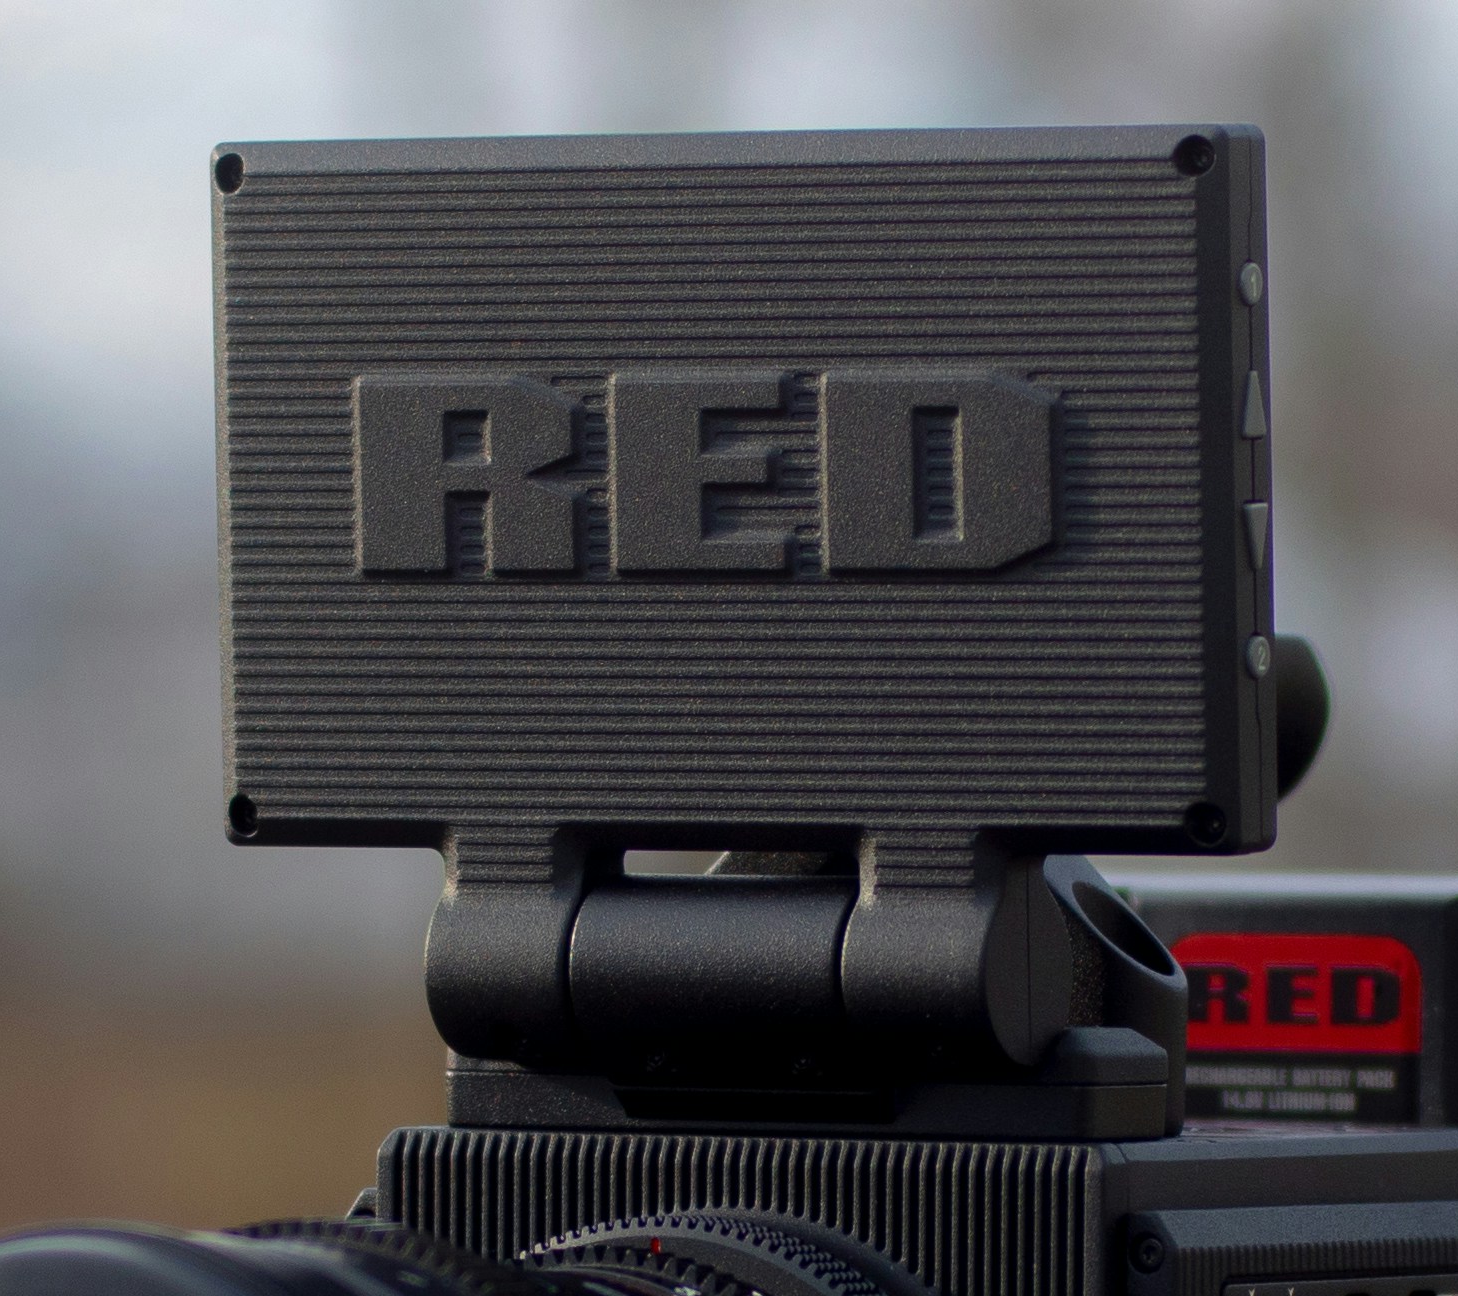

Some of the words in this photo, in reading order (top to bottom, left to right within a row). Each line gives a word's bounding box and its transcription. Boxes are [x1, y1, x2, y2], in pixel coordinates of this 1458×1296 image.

[352, 369, 1064, 576] RED
[1258, 646, 1268, 672] 2
[1185, 963, 1400, 1025] RED
